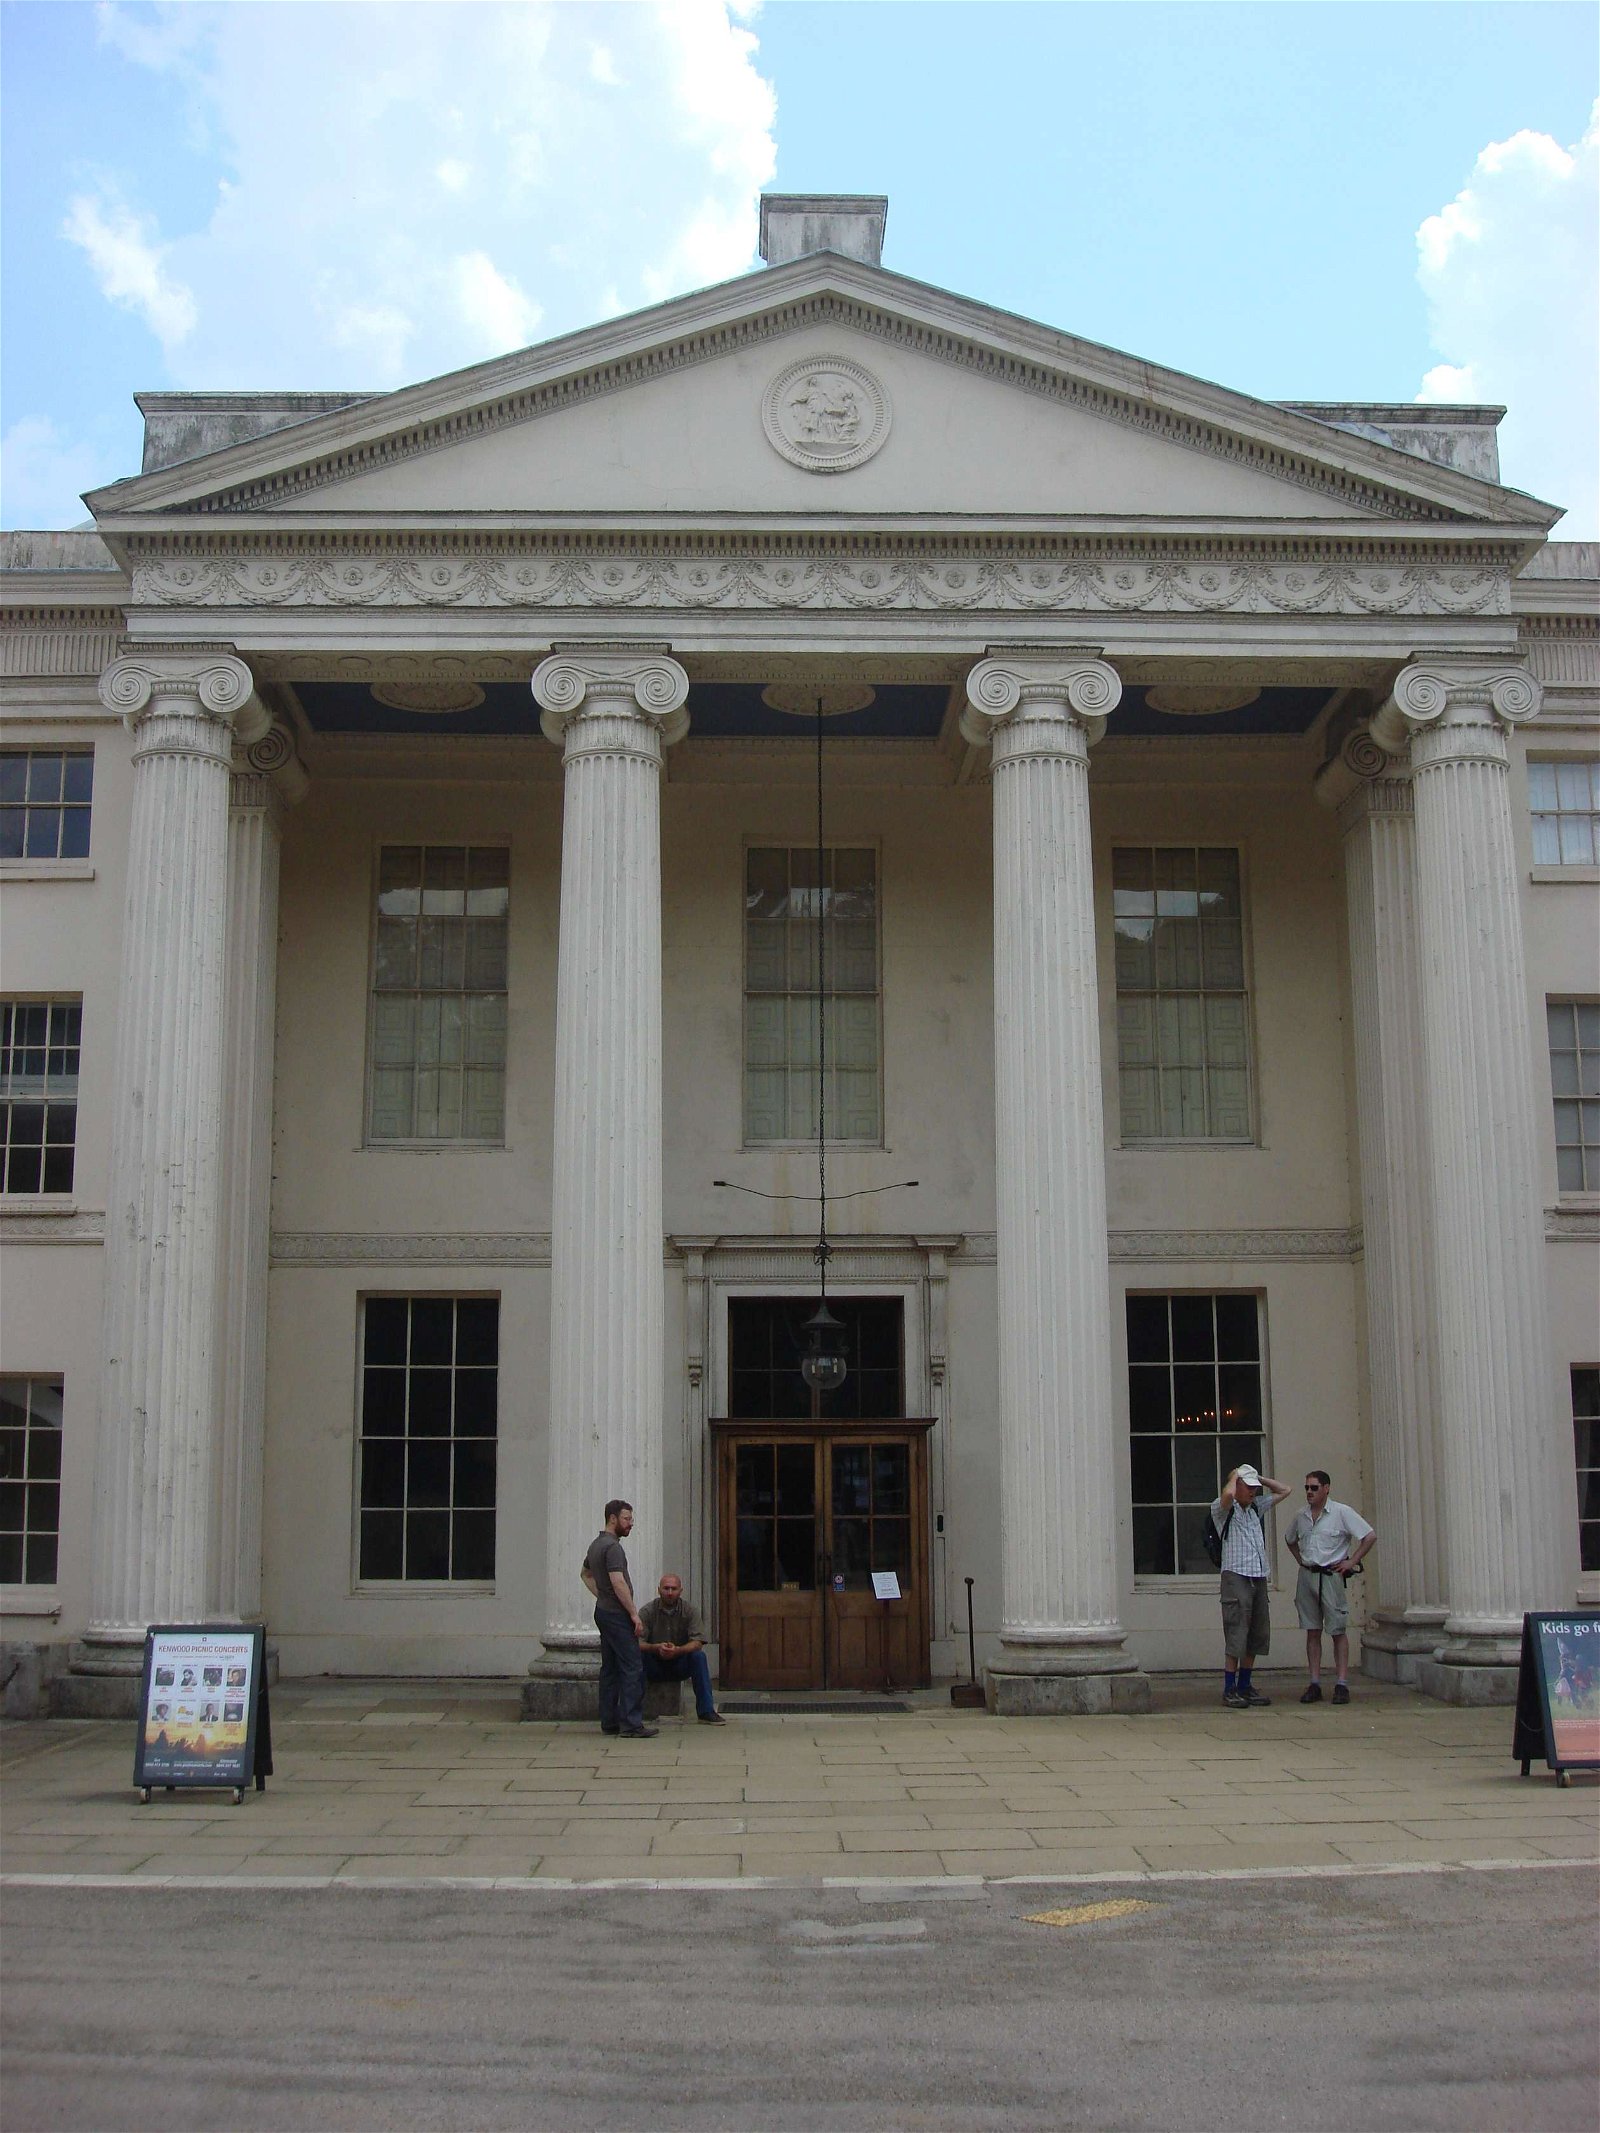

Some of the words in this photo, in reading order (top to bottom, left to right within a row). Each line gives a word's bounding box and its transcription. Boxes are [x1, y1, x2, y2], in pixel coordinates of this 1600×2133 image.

[1541, 1622, 1570, 1633] Kids
[1574, 1624, 1590, 1636] go
[158, 1645, 190, 1653] KENWOOD
[191, 1645, 213, 1653] PICNIC
[214, 1646, 248, 1654] CONCERTS
